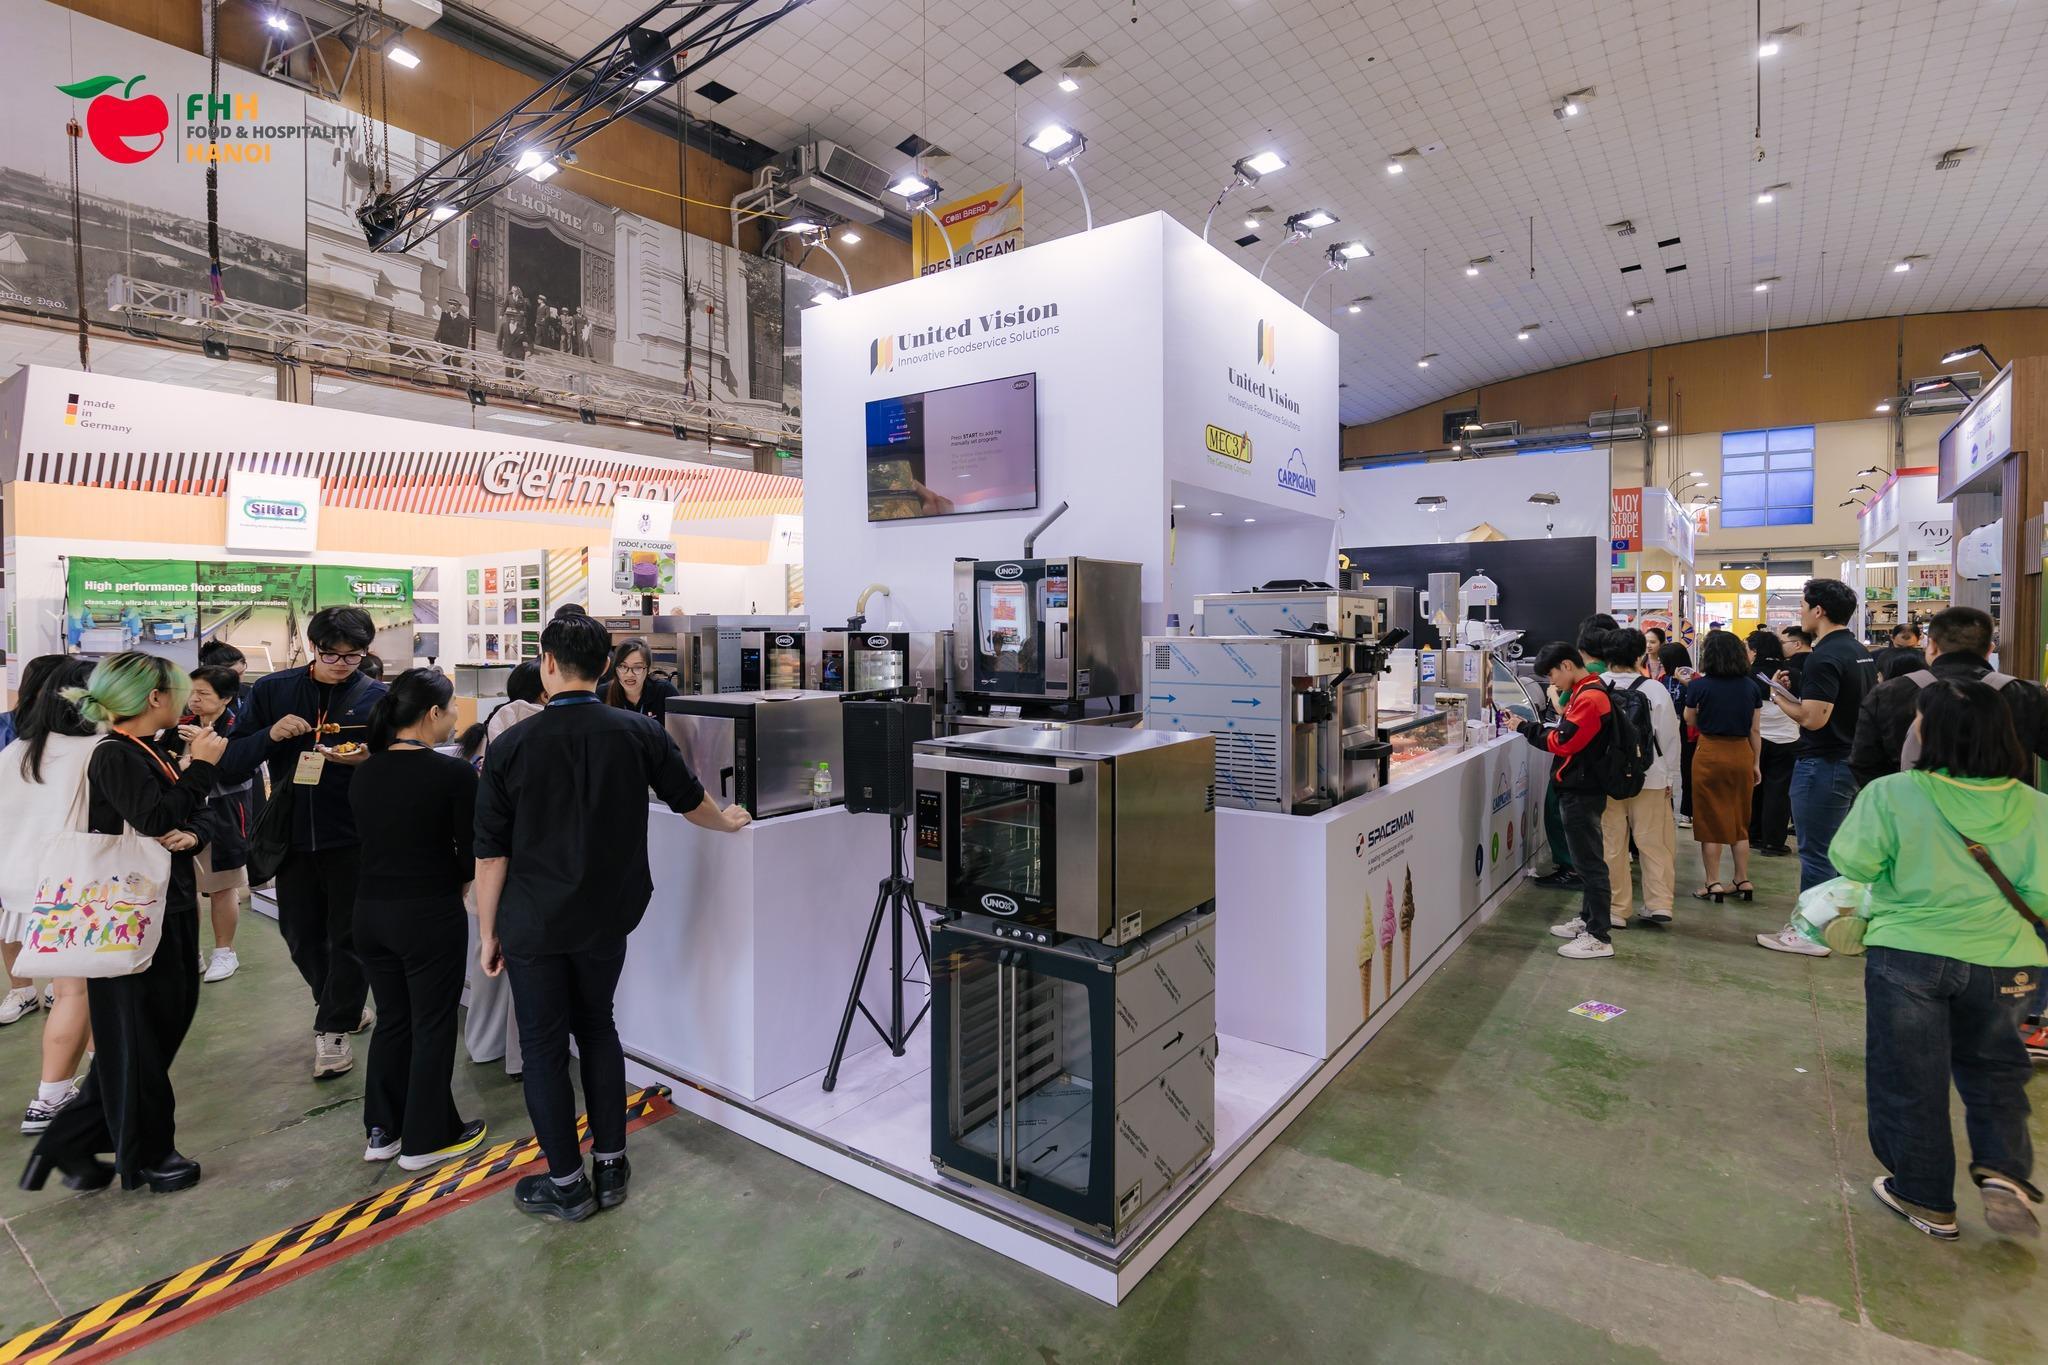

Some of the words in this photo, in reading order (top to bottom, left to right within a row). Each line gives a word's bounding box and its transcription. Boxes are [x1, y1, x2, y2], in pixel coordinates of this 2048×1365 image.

[966, 239, 1015, 265] CREAM
[898, 318, 972, 350] United
[979, 302, 1059, 332] Vision
[898, 350, 945, 367] Innovative
[947, 335, 1007, 356] Foodservice
[1009, 325, 1060, 344] Solutions
[1227, 367, 1265, 399] United
[1268, 387, 1300, 415] Vision
[83, 400, 116, 410] made
[81, 409, 92, 417] in
[80, 420, 132, 435] Germany
[1208, 428, 1240, 457] MEC3
[482, 452, 688, 507] Germany
[1278, 468, 1316, 493] CARPIGIANI
[251, 503, 298, 516] Silikal
[1611, 494, 1639, 512] NJOY
[1618, 512, 1639, 525] FROM
[1923, 528, 1949, 537] JVD
[999, 567, 1020, 575] UNOX
[84, 581, 112, 592] High
[115, 582, 188, 592] performance
[191, 582, 216, 592] floor
[218, 583, 263, 593] coatings
[1694, 573, 1727, 587] MA
[353, 582, 397, 594] Silikal
[959, 592, 968, 671] CHETOP
[1368, 810, 1414, 848] SPACEMAN
[985, 898, 1012, 911] UNOX
